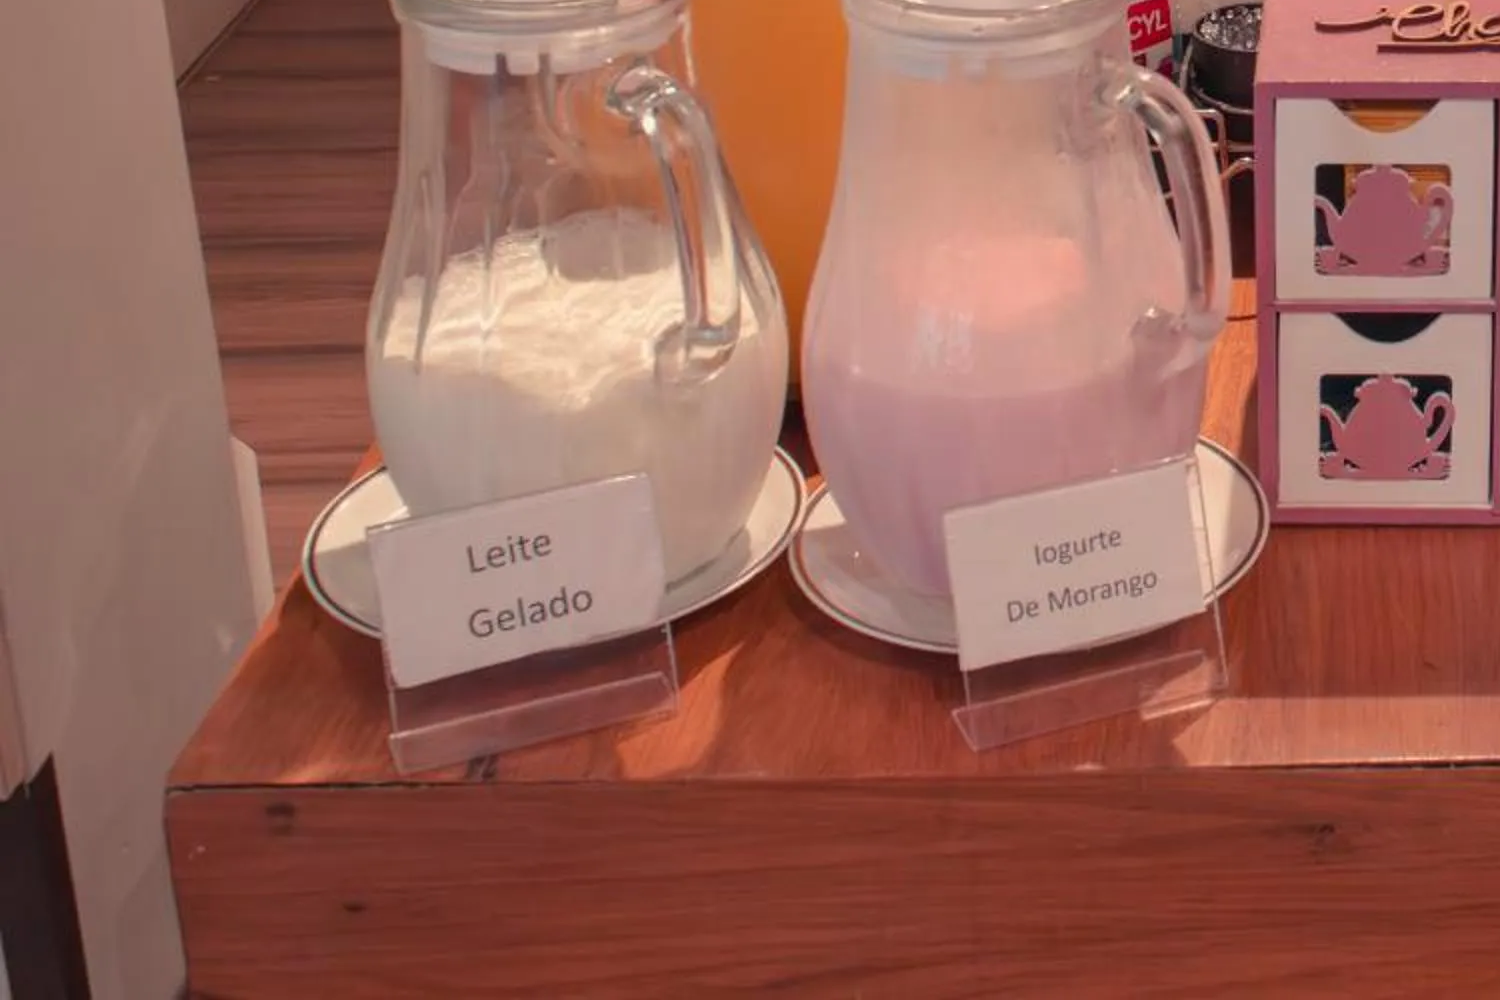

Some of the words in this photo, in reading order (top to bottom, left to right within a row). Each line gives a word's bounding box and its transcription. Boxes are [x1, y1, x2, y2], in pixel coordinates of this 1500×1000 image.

[1128, 9, 1168, 41] CYL
[466, 534, 552, 573] Leite
[1034, 530, 1121, 565] Iogurte
[468, 586, 593, 638] Gelado
[1006, 600, 1040, 623] De
[1047, 571, 1158, 613] Morango
